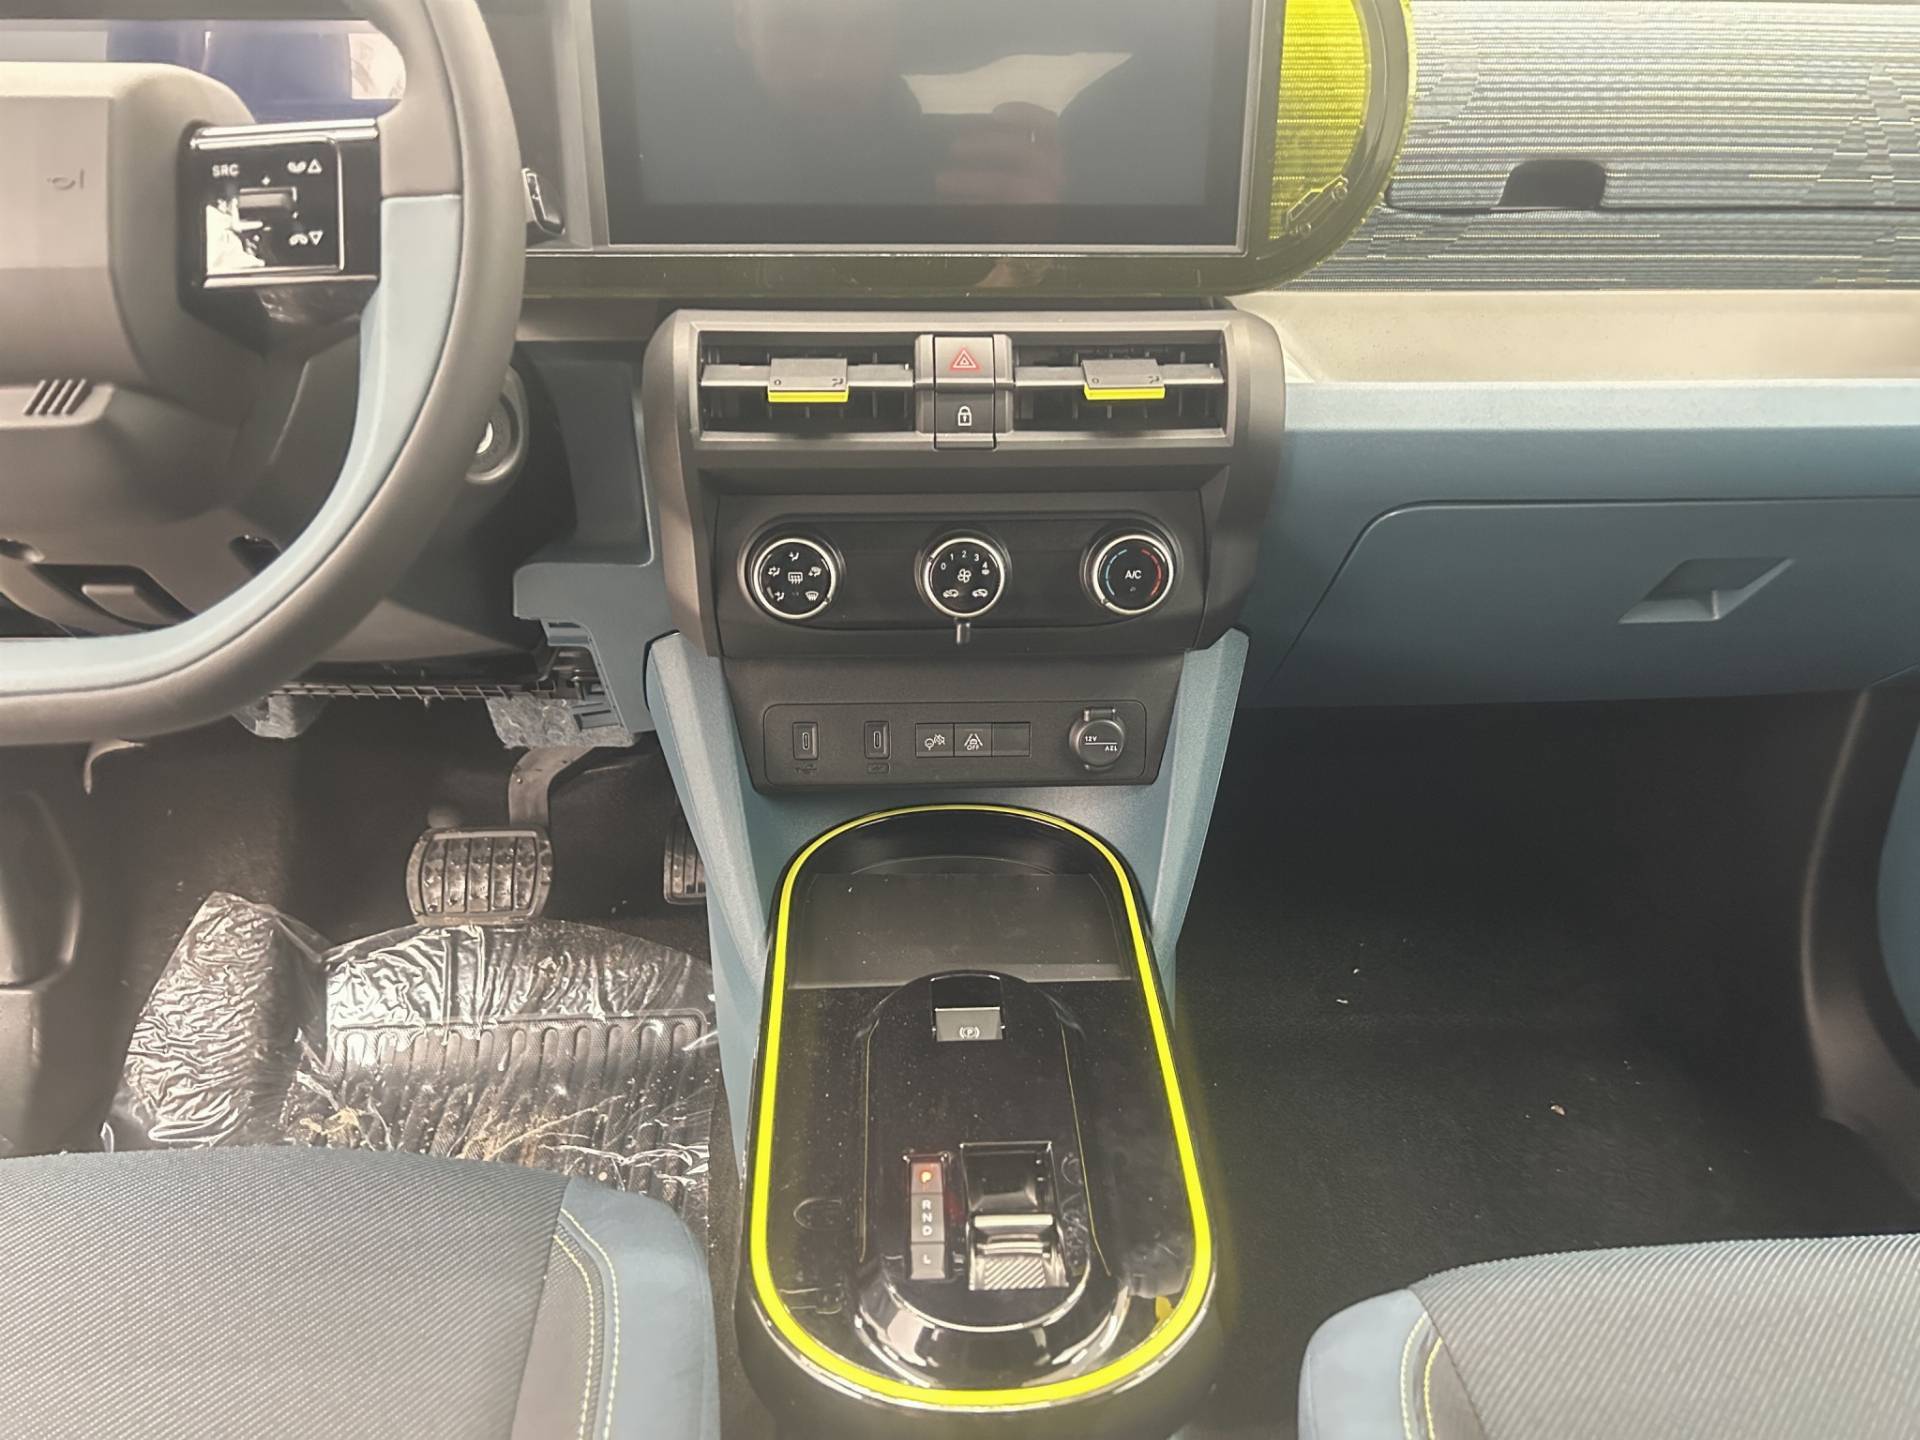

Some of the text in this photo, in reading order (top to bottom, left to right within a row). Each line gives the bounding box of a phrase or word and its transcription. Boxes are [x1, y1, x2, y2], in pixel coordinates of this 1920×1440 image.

[212, 163, 240, 178] SRC
[940, 550, 988, 571] 0 1 2 3 4
[1124, 570, 1142, 580] A/C
[921, 1171, 932, 1183] P
[922, 1200, 931, 1209] R
[922, 1213, 932, 1223] N
[922, 1225, 932, 1236] D
[923, 1254, 931, 1264] L
